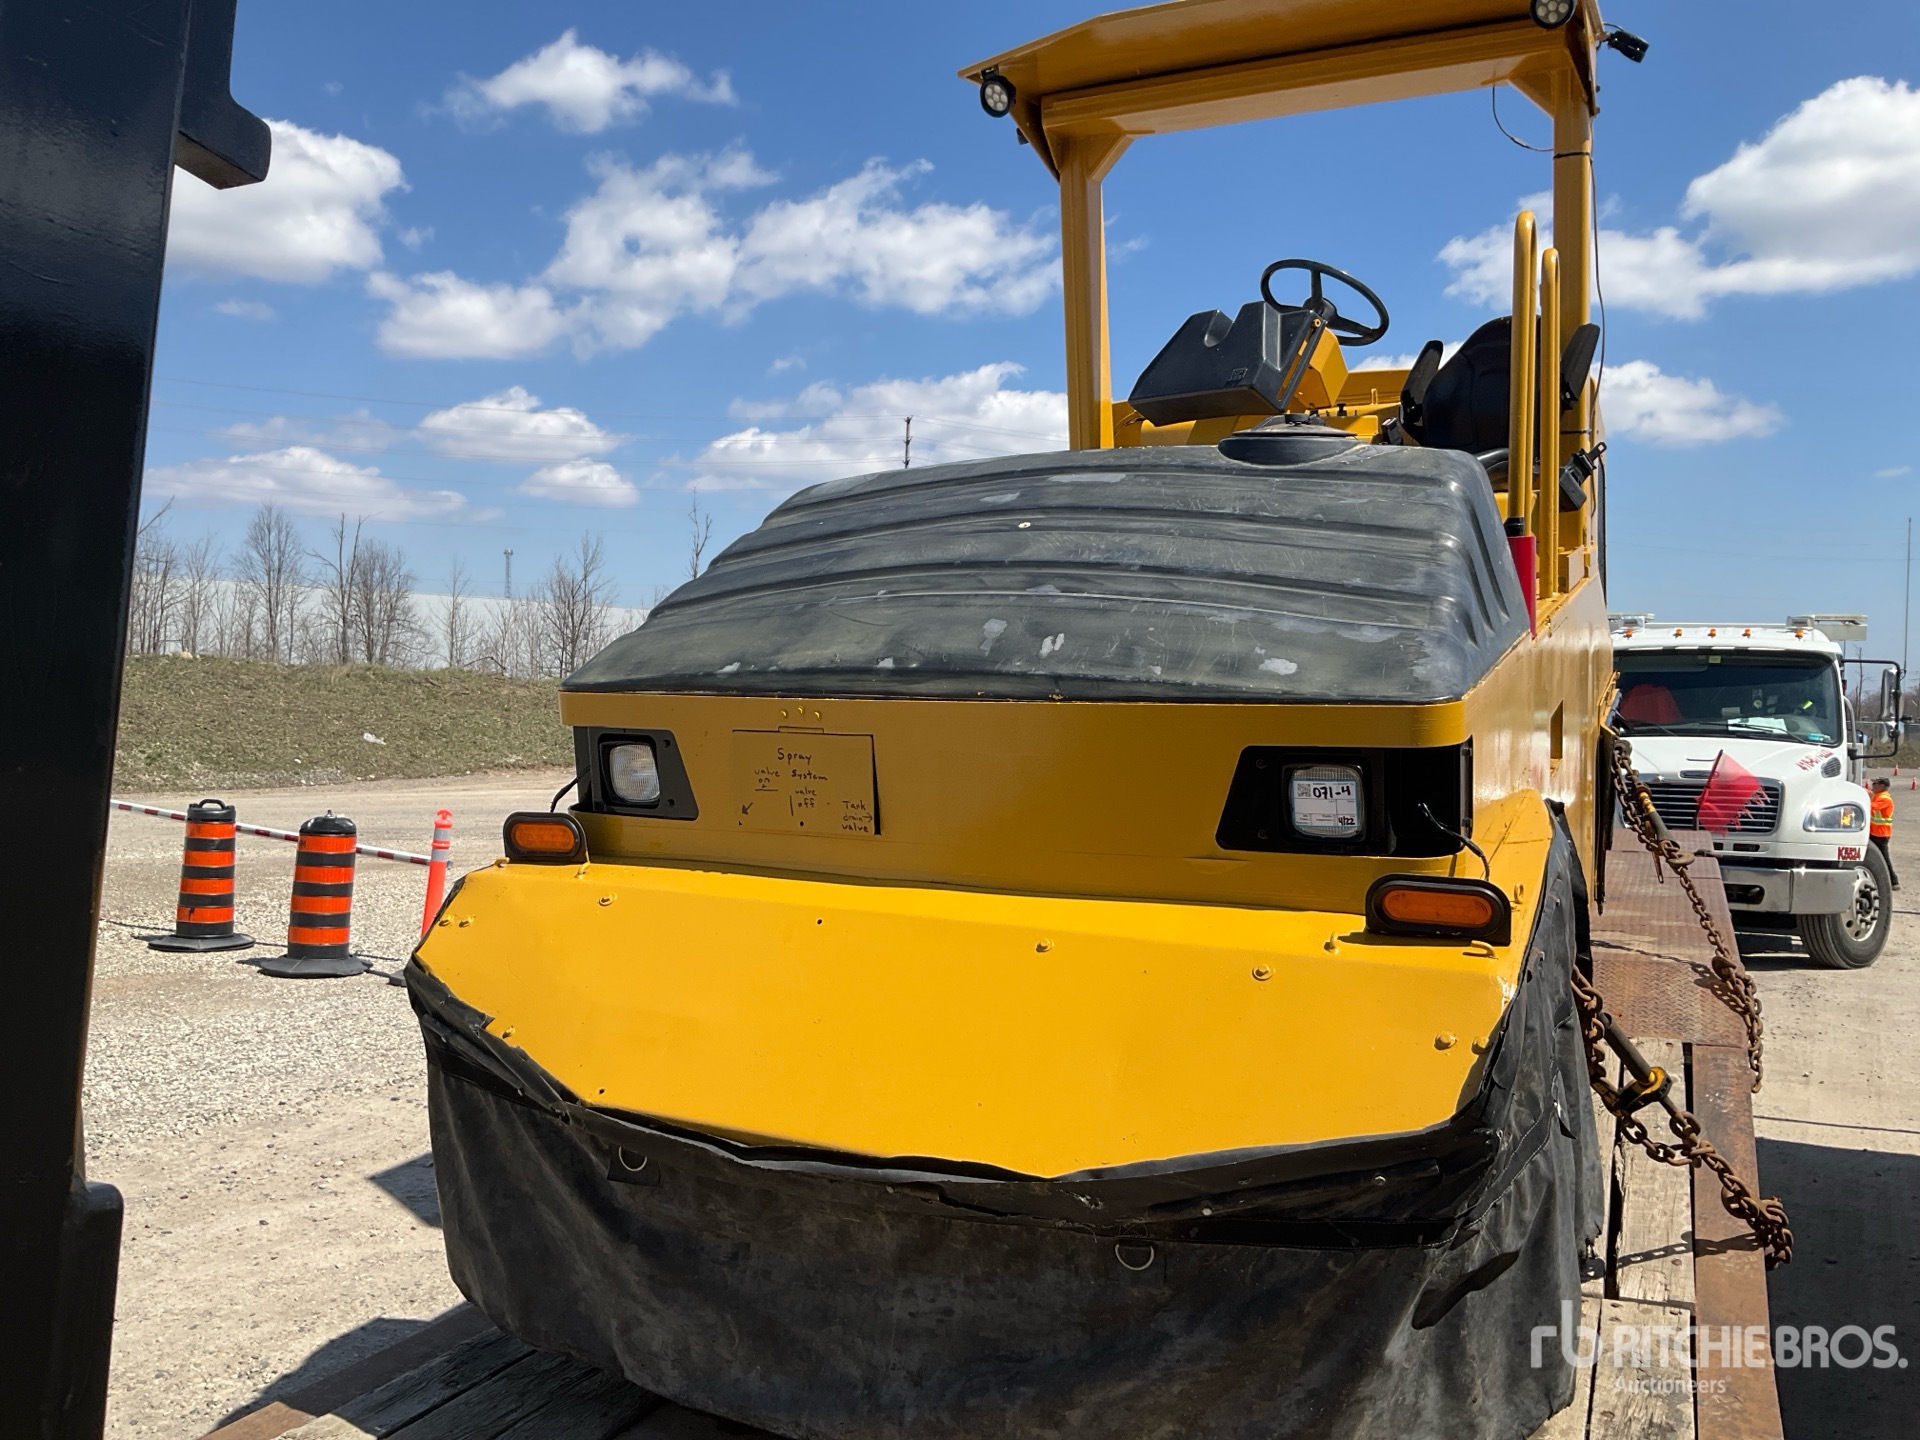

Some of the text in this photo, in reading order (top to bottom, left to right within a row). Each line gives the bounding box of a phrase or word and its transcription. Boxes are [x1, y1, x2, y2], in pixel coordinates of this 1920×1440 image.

[777, 747, 812, 766] Spray
[791, 769, 828, 780] System
[1312, 785, 1351, 800] 071-4
[797, 797, 815, 808] off
[842, 799, 866, 811] Tank
[842, 812, 863, 822] drain
